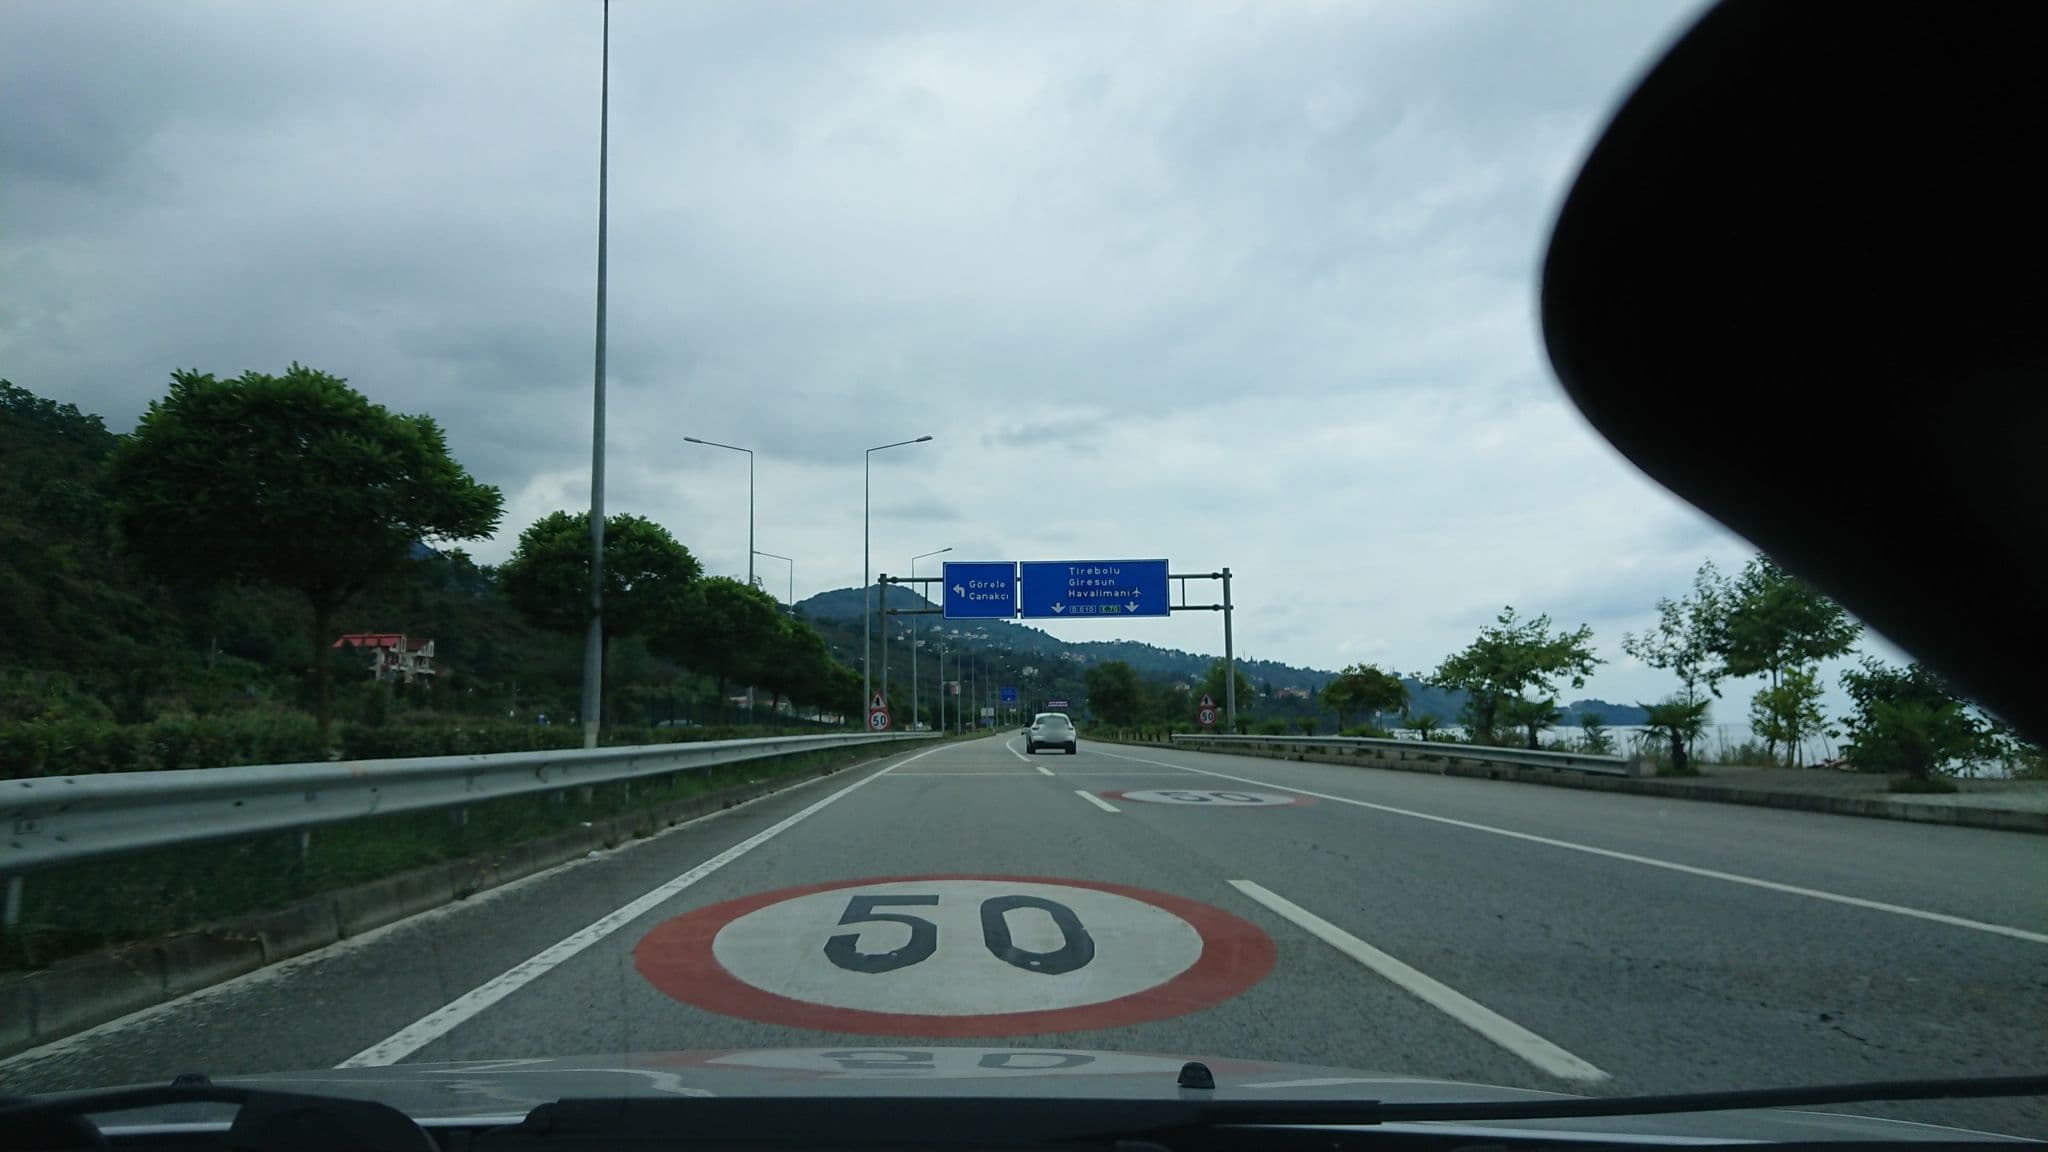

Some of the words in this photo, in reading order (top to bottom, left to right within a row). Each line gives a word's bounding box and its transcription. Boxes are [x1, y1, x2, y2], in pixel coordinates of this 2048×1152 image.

[1069, 567, 1120, 575] Tirebolu
[969, 579, 1006, 588] Görele
[1069, 578, 1115, 586] Giresun
[873, 715, 886, 726] 50
[1202, 712, 1213, 721] 50
[823, 894, 1095, 975] 50
